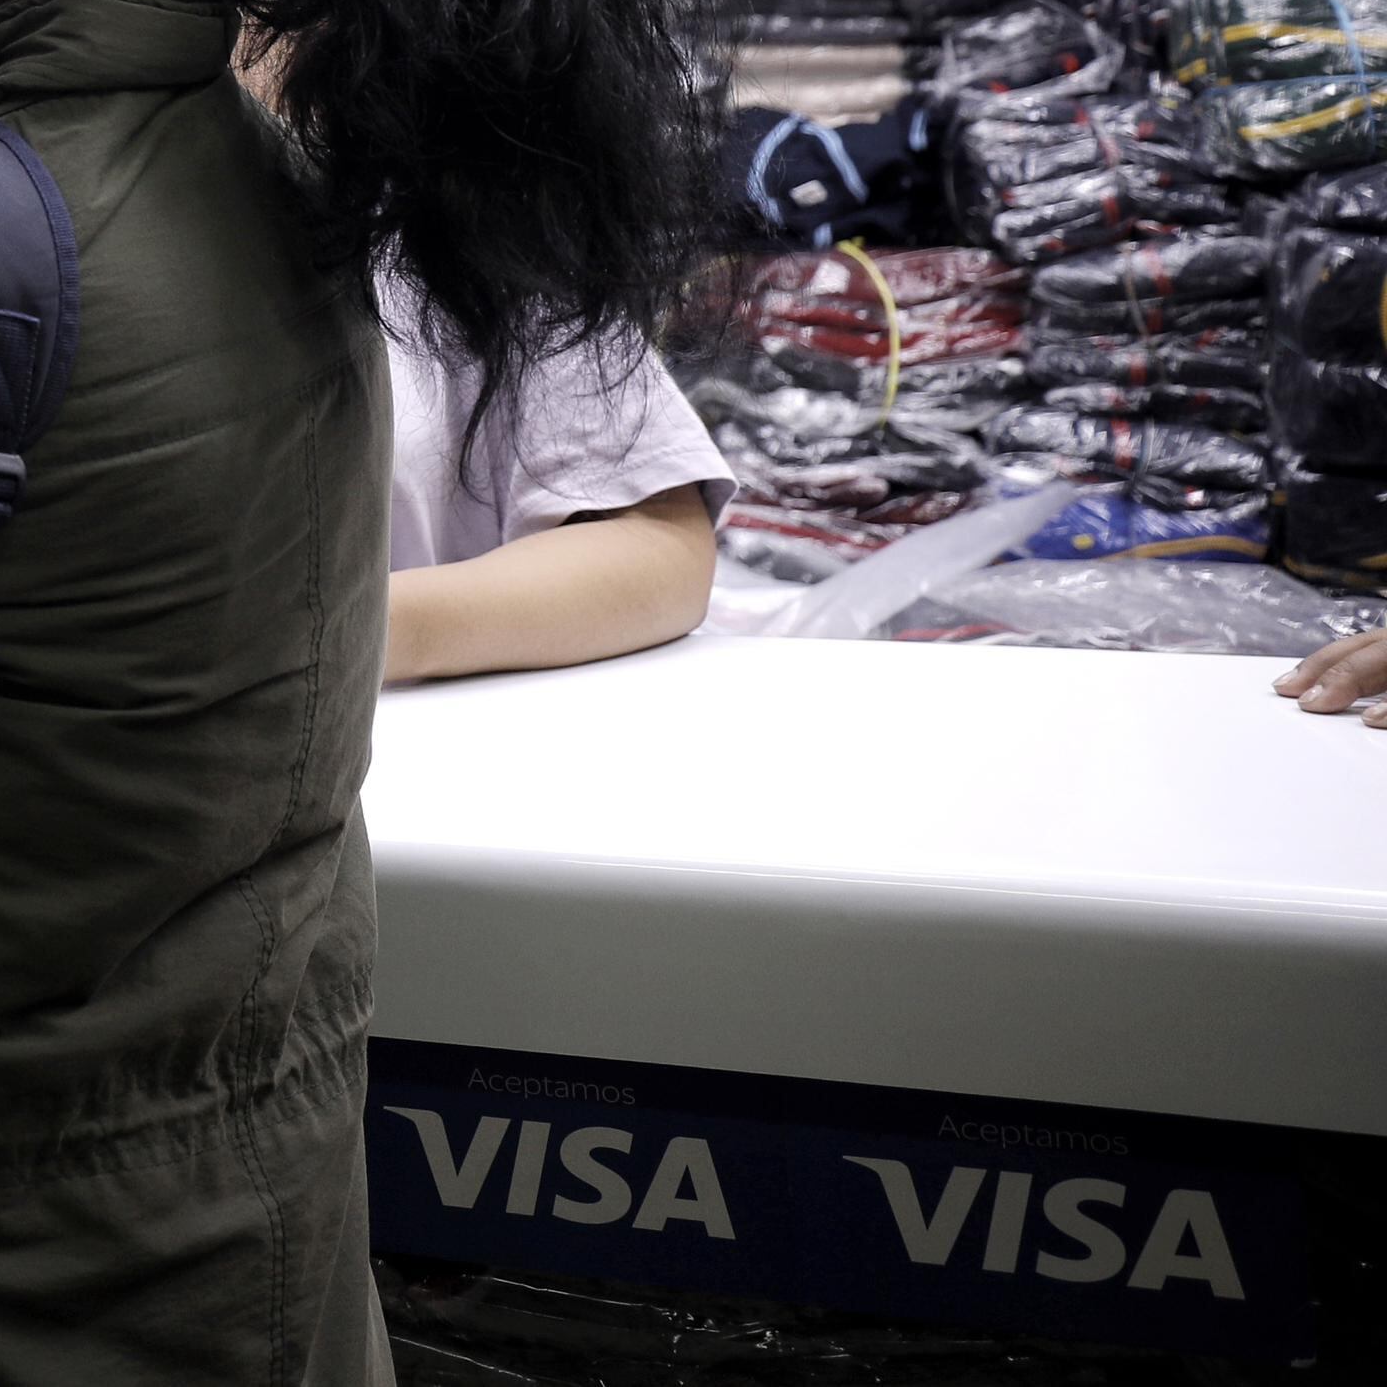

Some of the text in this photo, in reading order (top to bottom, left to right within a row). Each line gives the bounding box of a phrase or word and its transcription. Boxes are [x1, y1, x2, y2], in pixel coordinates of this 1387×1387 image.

[467, 1067, 636, 1106] Aceptamos
[383, 1105, 737, 1241] VISA
[938, 1114, 1129, 1155] Aceptamos
[842, 1154, 1246, 1301] VISA
